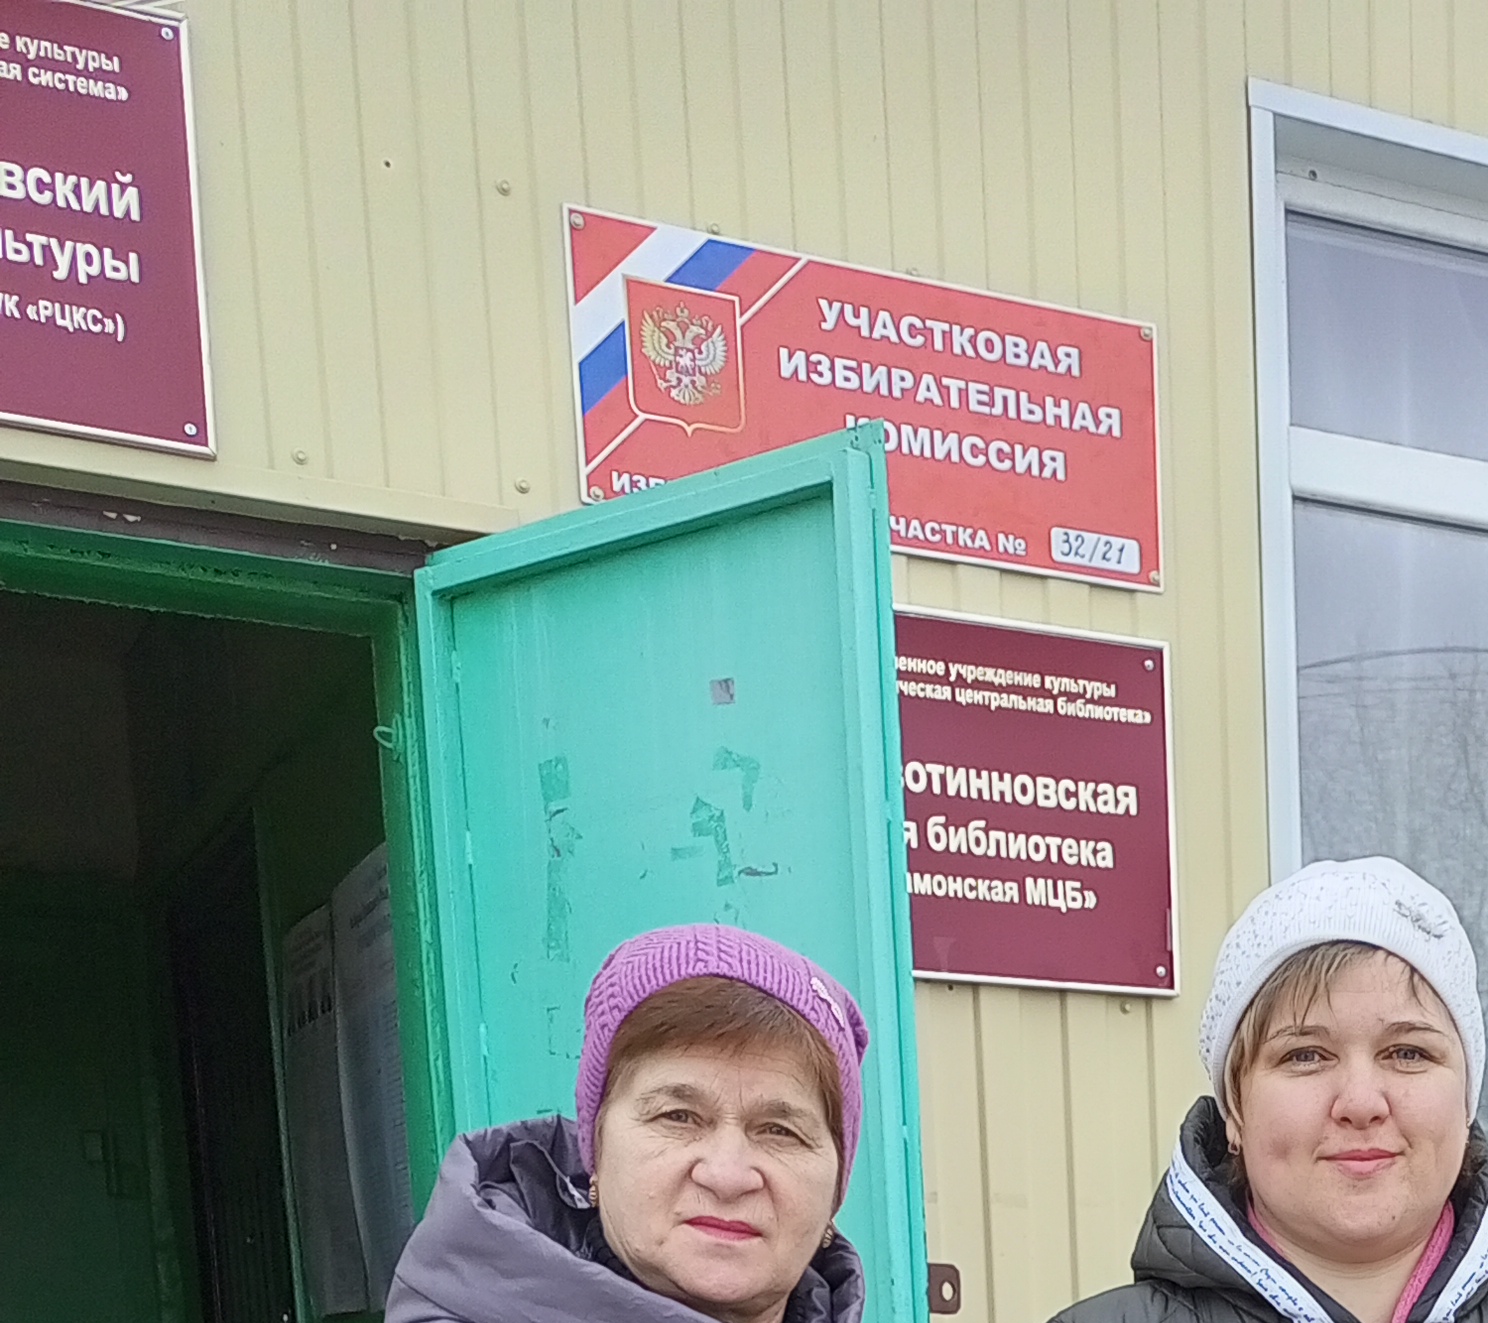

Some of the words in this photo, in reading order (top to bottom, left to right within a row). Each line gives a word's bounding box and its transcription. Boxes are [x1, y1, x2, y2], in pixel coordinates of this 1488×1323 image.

[15, 35, 120, 73] культуры
[28, 66, 129, 101] система»
[0, 226, 140, 284] ьтуры
[817, 297, 1082, 378] УЧАСТКОВАЯ
[778, 346, 1123, 439] ИЗБИРАТЕЛЬНАЯ
[845, 414, 1068, 482] ОМИССИЯ
[1058, 532, 1128, 566] 32/21
[949, 661, 1042, 689] учреждение
[1044, 675, 1116, 699] культуры
[955, 686, 1054, 714] центральная
[900, 760, 1138, 816] отинновская
[927, 815, 1115, 869] библиотека
[1025, 877, 1098, 913] МЦБ»
